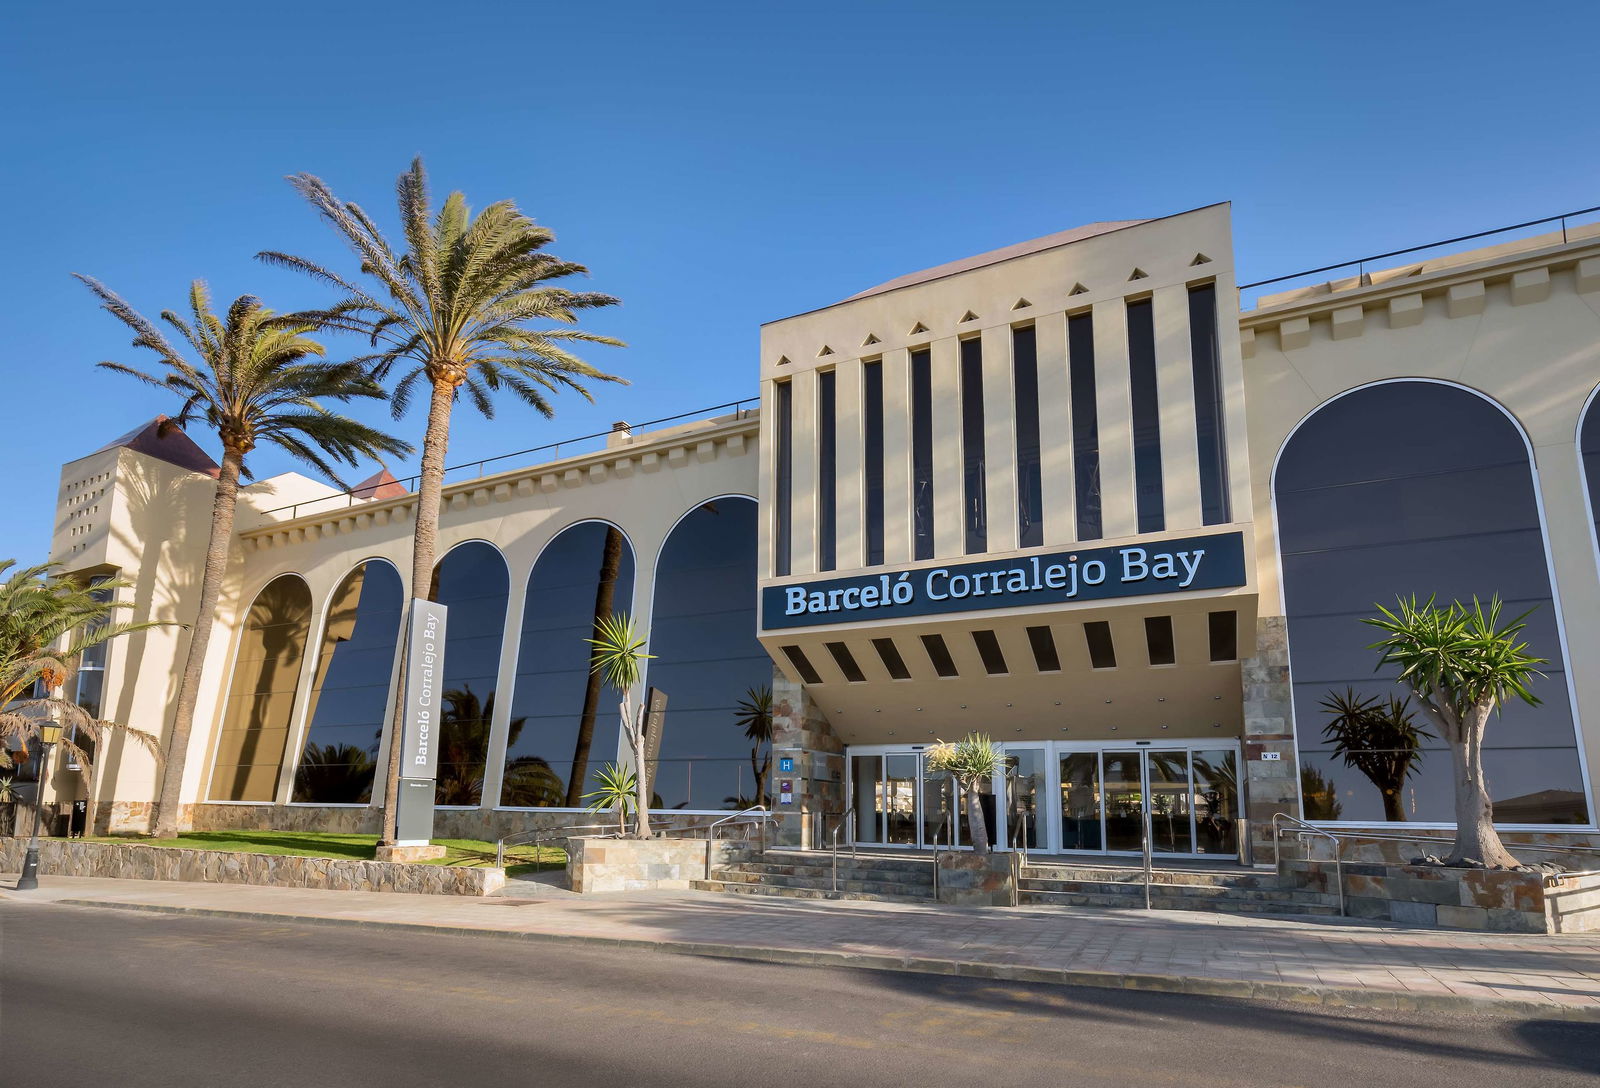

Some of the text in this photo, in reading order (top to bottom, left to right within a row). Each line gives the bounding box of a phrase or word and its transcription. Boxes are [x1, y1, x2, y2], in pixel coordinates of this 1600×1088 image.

[784, 547, 1205, 616] Barceló Corralejo Bay
[424, 612, 440, 639] Bay
[419, 643, 437, 706] Corralejo
[415, 710, 430, 766] Barceló
[783, 760, 790, 770] H
